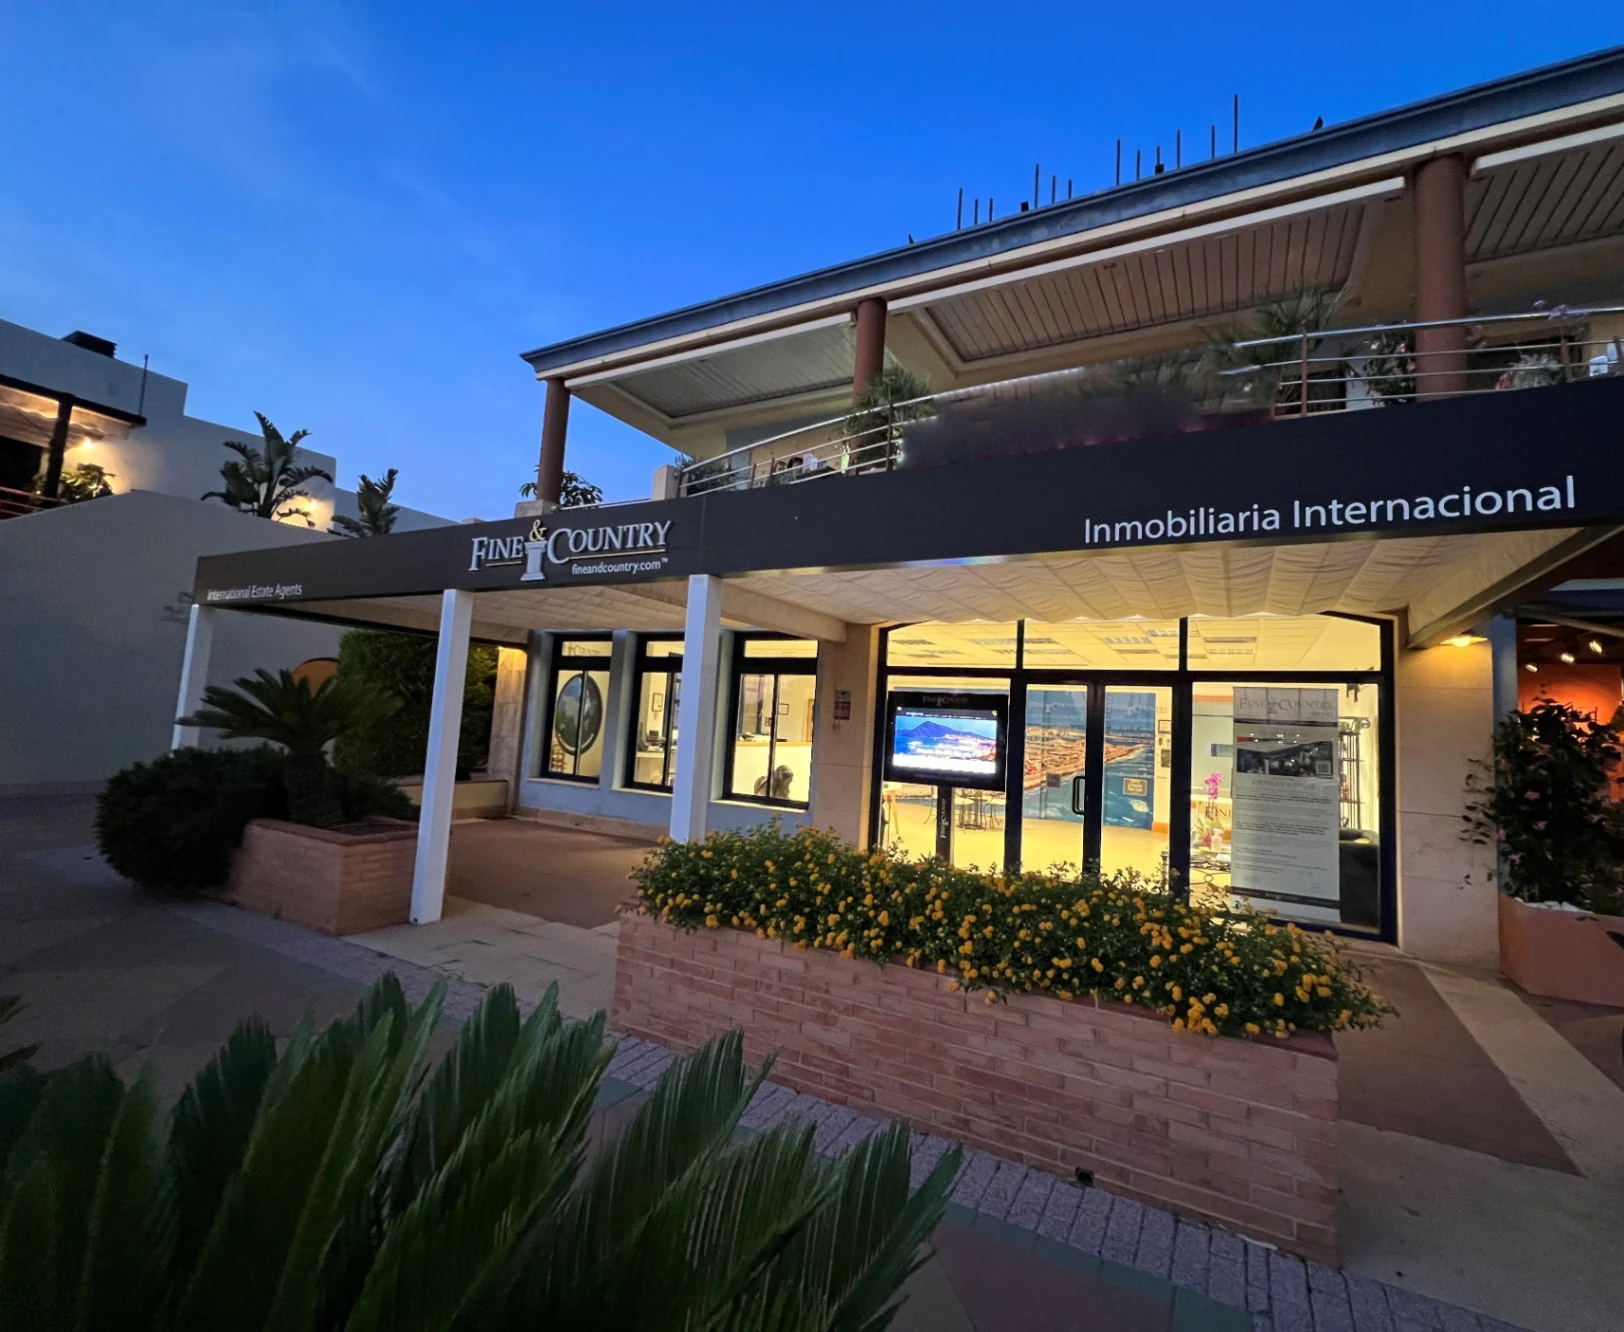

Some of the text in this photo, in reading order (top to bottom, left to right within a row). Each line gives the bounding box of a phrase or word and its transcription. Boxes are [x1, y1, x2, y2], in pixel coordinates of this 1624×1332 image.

[1085, 475, 1576, 543] Inmobiliaria Internacional
[468, 519, 672, 571] FINE & COUNTRY
[207, 583, 303, 601] International Estate Agents
